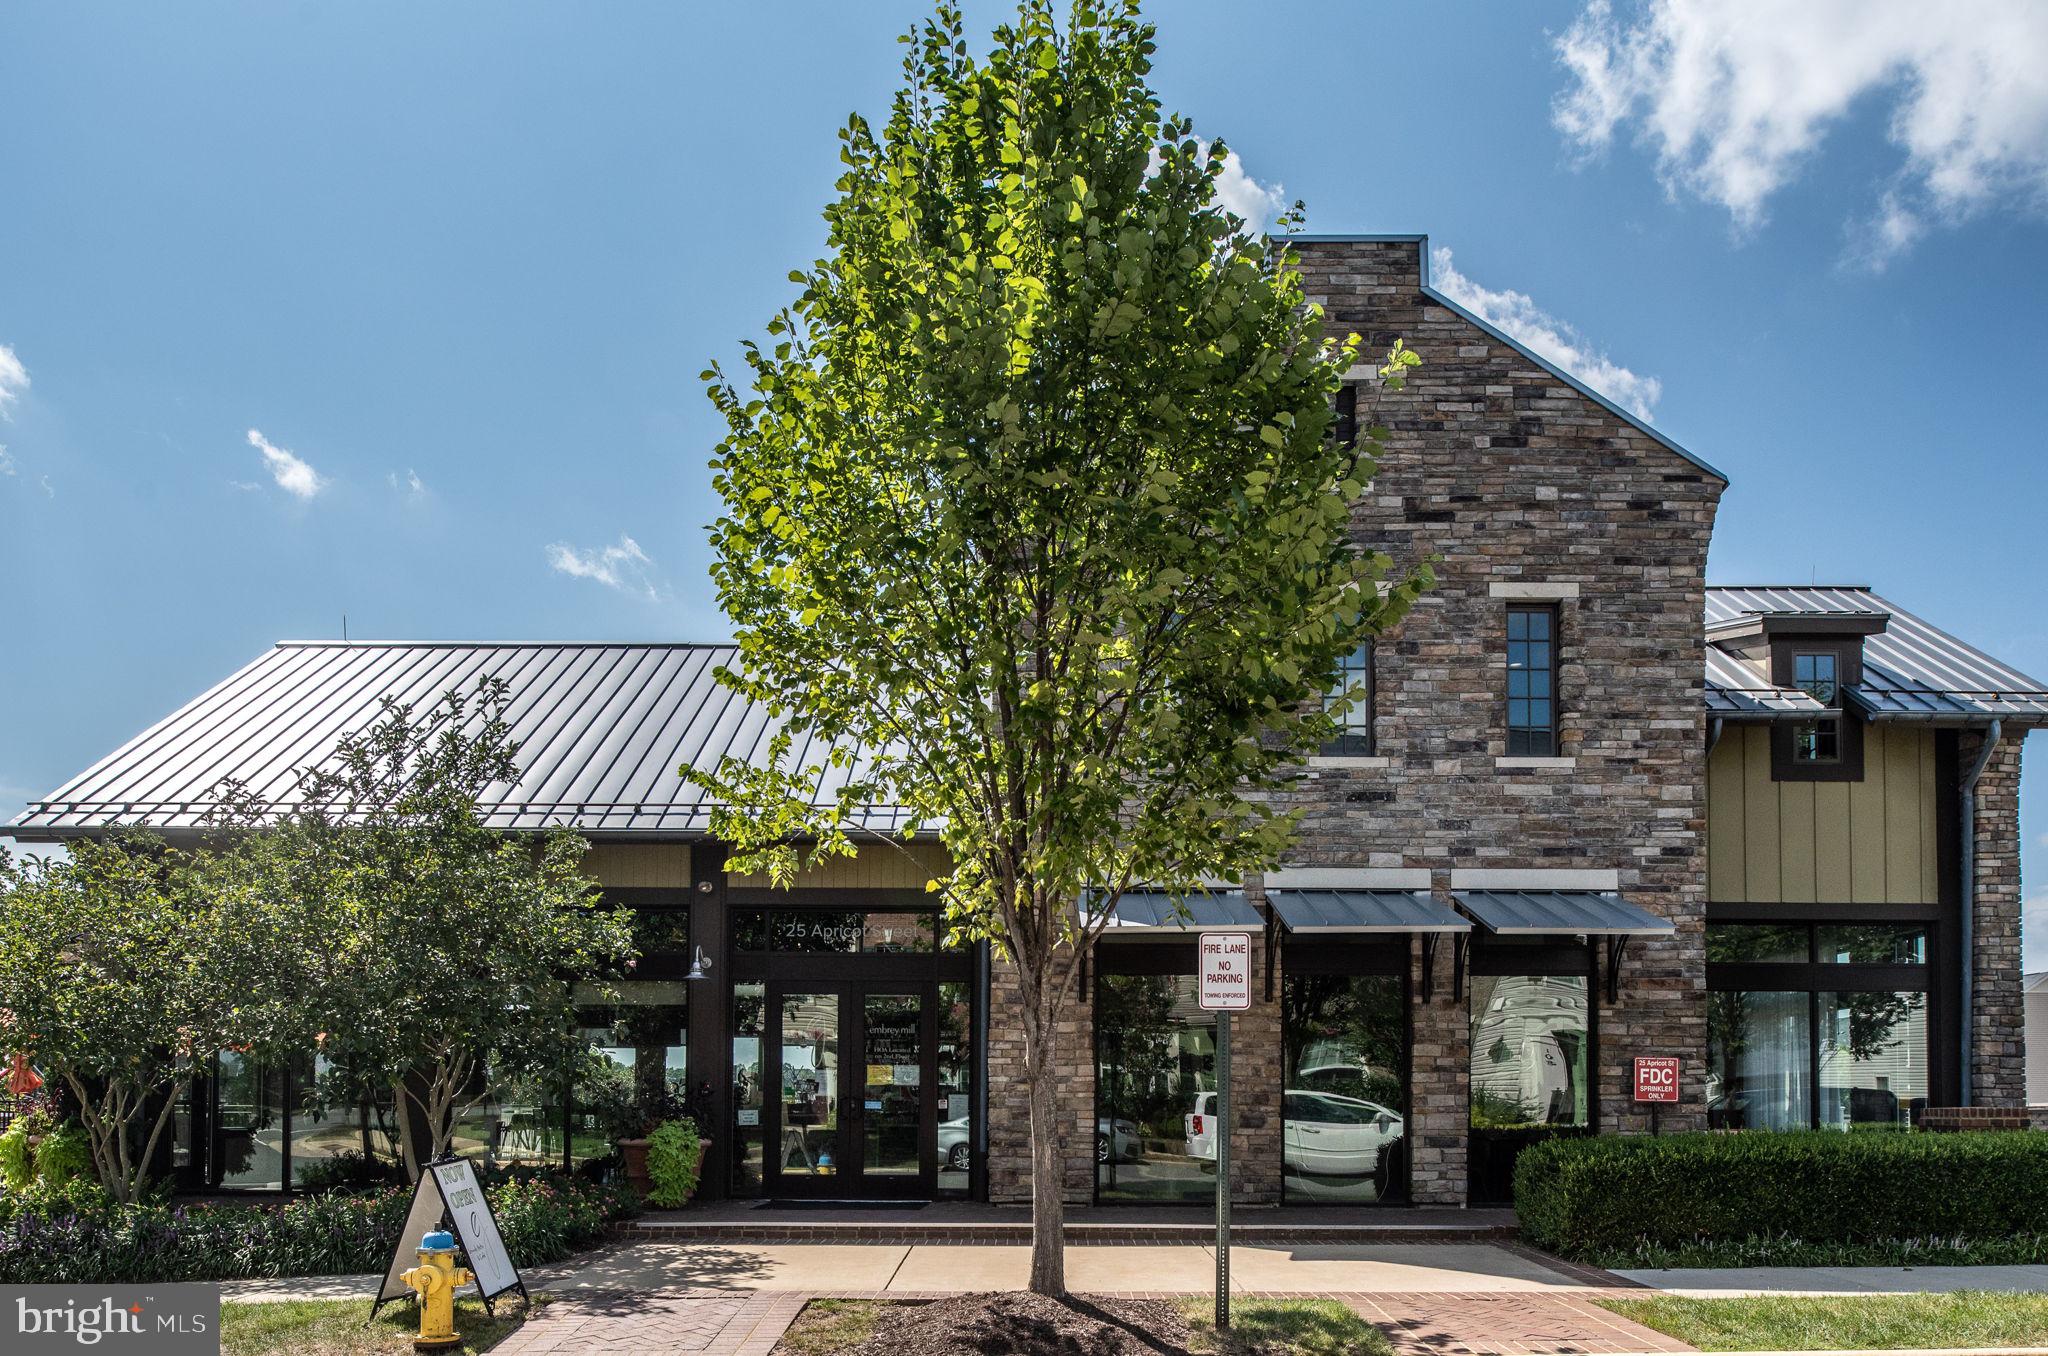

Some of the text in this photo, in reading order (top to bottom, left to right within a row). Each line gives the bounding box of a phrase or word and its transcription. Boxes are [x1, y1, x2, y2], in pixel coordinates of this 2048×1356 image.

[786, 923, 806, 938] 25
[811, 923, 866, 942] Apricot
[1204, 944, 1246, 953] FIRE LANE
[1219, 961, 1231, 970] NO
[1207, 974, 1243, 983] PARKING
[869, 1023, 916, 1036] embrey mill
[1640, 1068, 1673, 1084] FDC
[440, 1164, 466, 1184] NOW
[449, 1187, 478, 1209] OPEN
